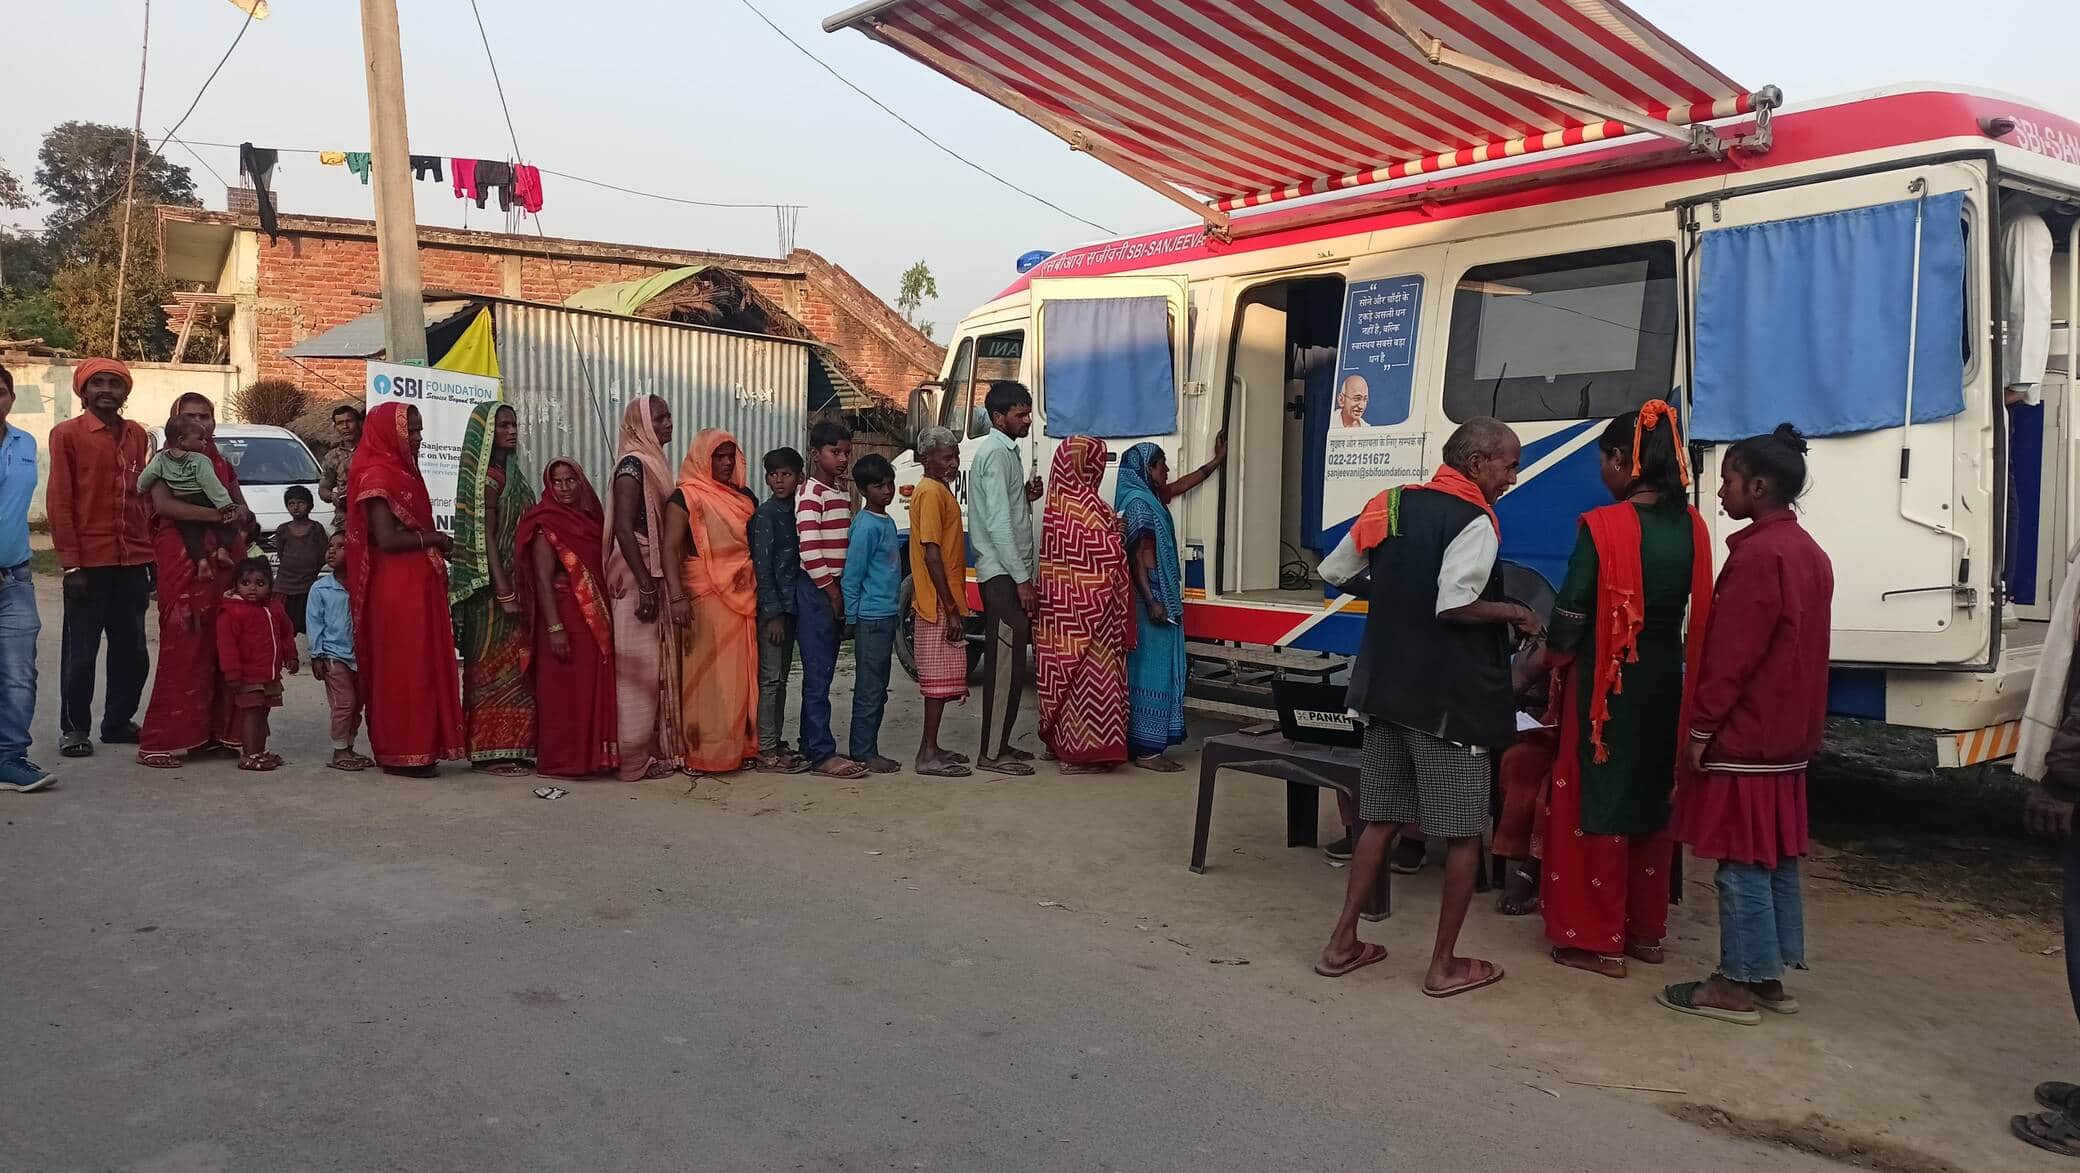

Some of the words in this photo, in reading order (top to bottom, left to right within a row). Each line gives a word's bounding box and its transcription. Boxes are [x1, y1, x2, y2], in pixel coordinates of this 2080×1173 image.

[1127, 232, 1207, 260] SBI-SANJEEVA
[1373, 294, 1386, 305] और
[1402, 291, 1410, 301] के
[1376, 337, 1392, 348] सबसे
[393, 376, 423, 400] SBI
[425, 380, 492, 399] FOUNDATION
[421, 442, 463, 452] Sanjeevan
[1328, 452, 1391, 466] 022-22151672
[1327, 467, 1429, 479] sanjeevani@sbifoundation.coin
[430, 497, 451, 507] artner
